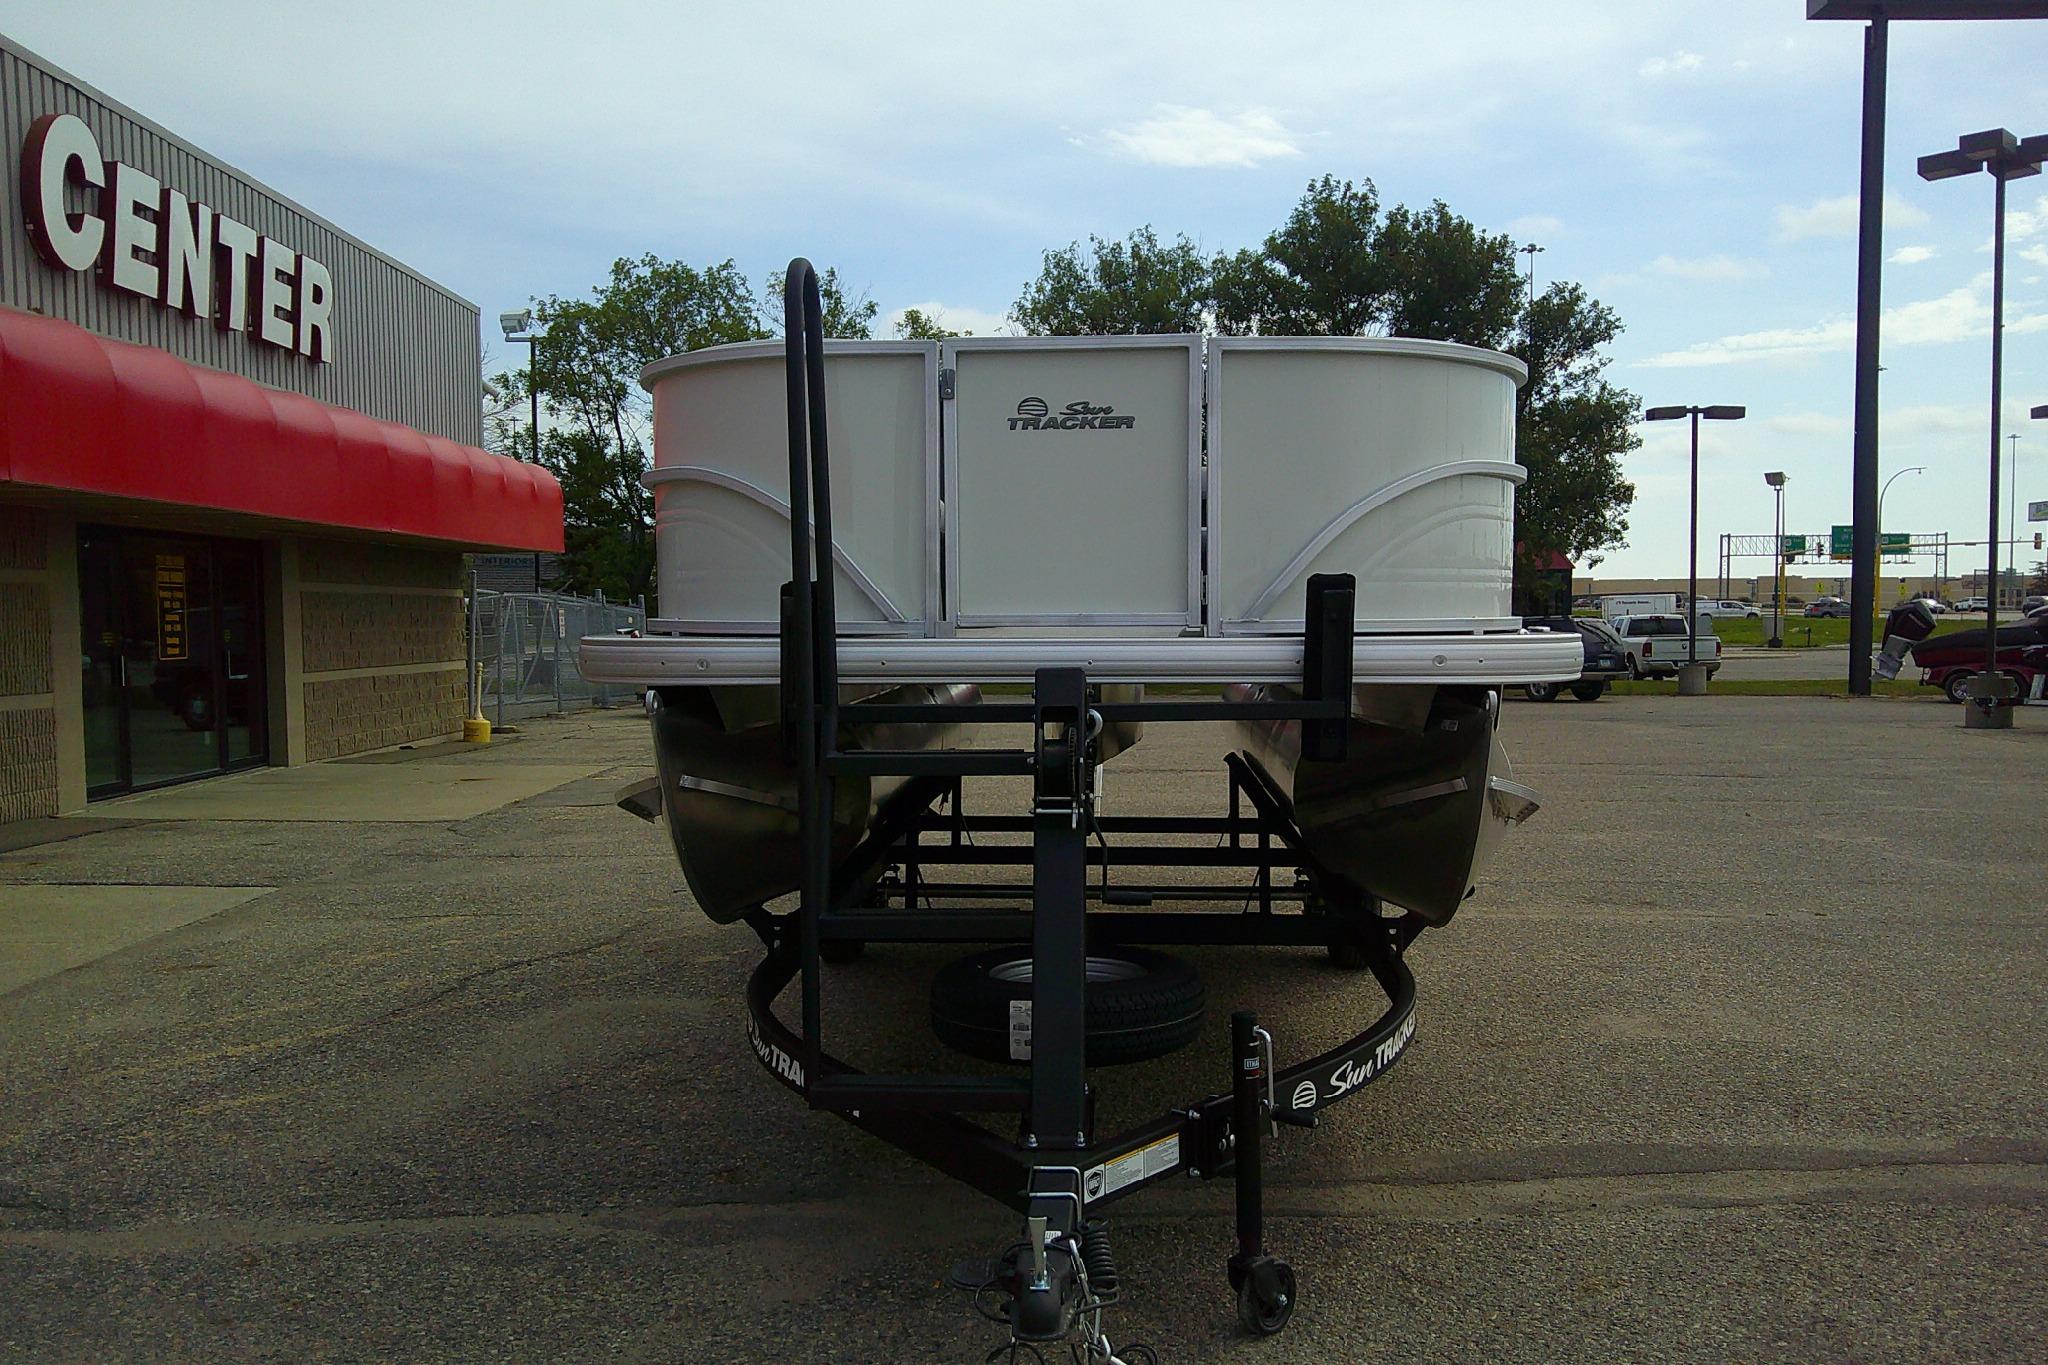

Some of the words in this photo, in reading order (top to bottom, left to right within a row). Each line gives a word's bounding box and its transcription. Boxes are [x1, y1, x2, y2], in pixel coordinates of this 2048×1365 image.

[30, 114, 334, 363] CENTER
[1007, 416, 1136, 431] TRACKER
[1323, 1060, 1374, 1098] Sun
[1375, 1009, 1417, 1070] TRACKE
